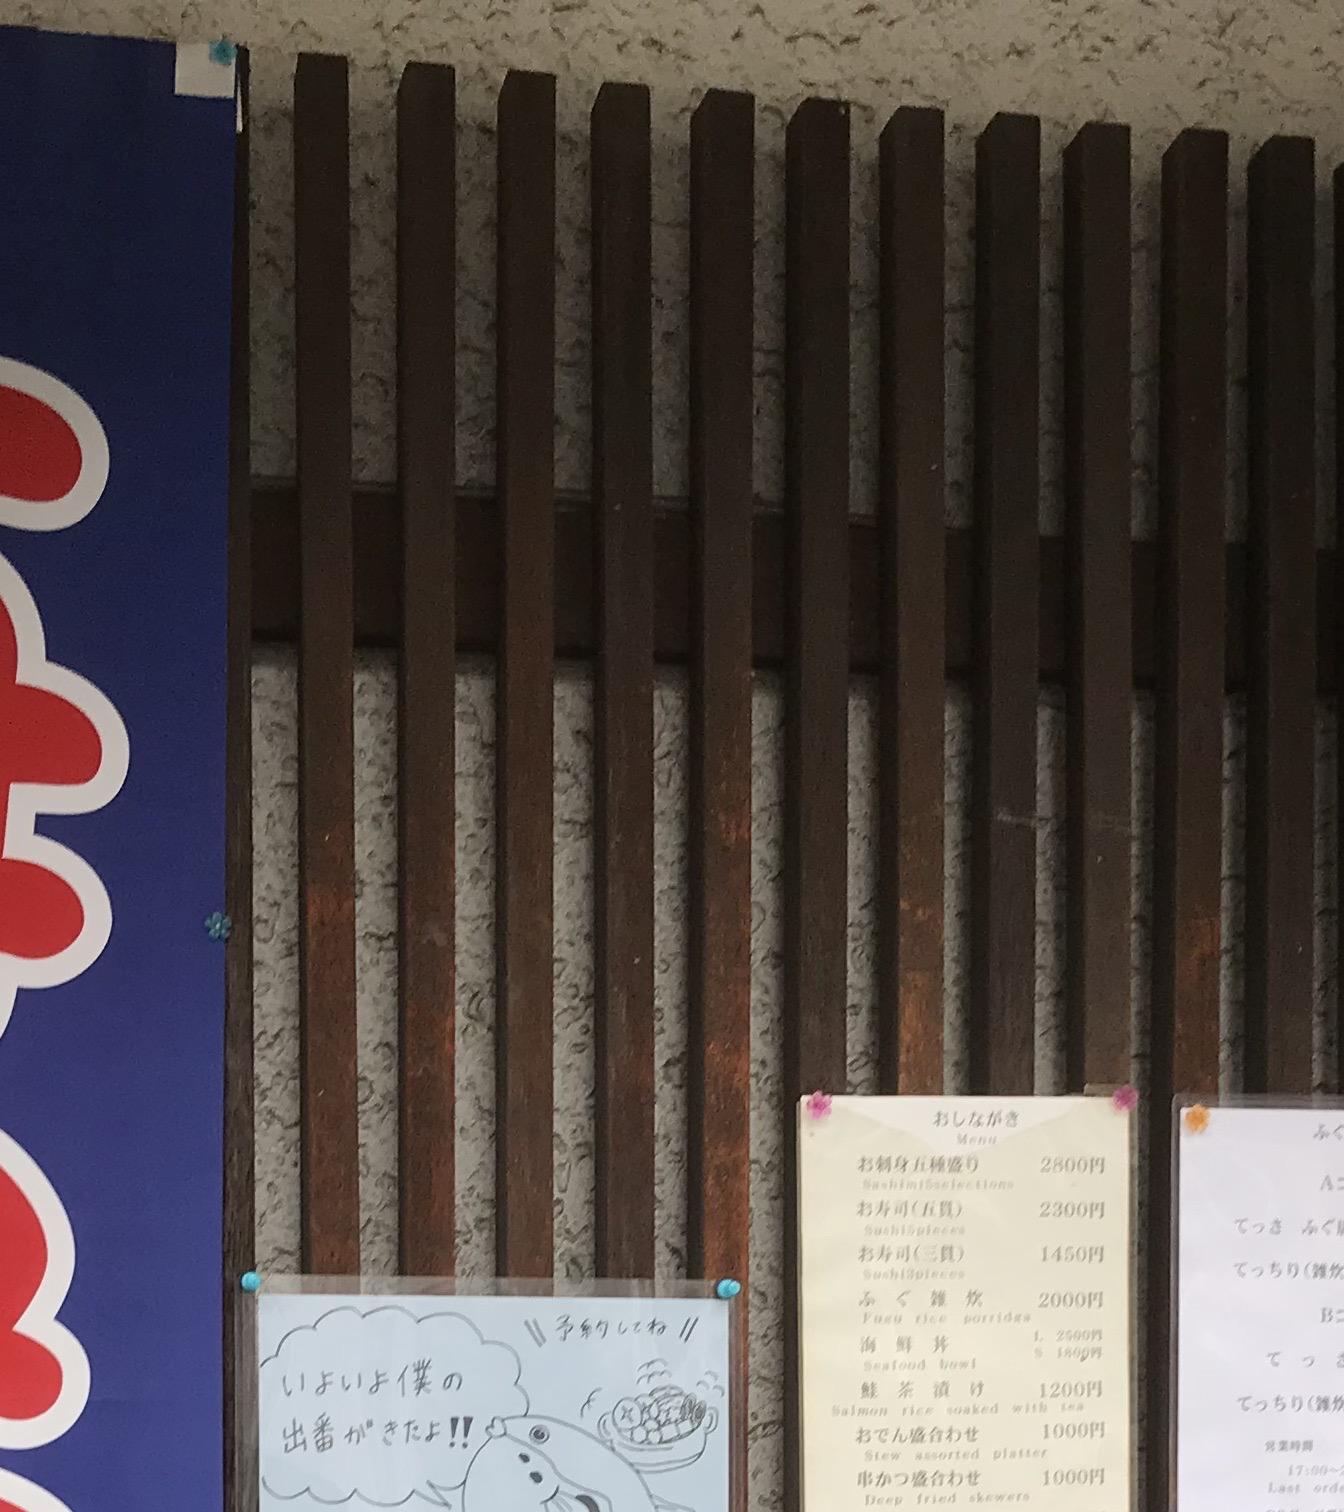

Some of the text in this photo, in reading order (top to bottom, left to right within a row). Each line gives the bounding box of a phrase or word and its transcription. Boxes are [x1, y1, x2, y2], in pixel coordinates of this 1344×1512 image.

[933, 1110, 1020, 1128] おしながき
[956, 1133, 998, 1145] Menu
[1040, 1156, 1105, 1174] 2800円
[1039, 1200, 1105, 1218] 2300円
[1040, 1246, 1104, 1263] 1450円
[1038, 1291, 1104, 1308] 2000円
[556, 1315, 666, 1340] 予約してね
[282, 1358, 463, 1397] いよいよ僕の
[1040, 1380, 1103, 1398] 1200円
[832, 1403, 888, 1417] Salmon
[902, 1403, 934, 1416] rice
[1012, 1402, 1048, 1414] with
[1043, 1422, 1105, 1440] 1000円
[1043, 1468, 1105, 1486] 1000円
